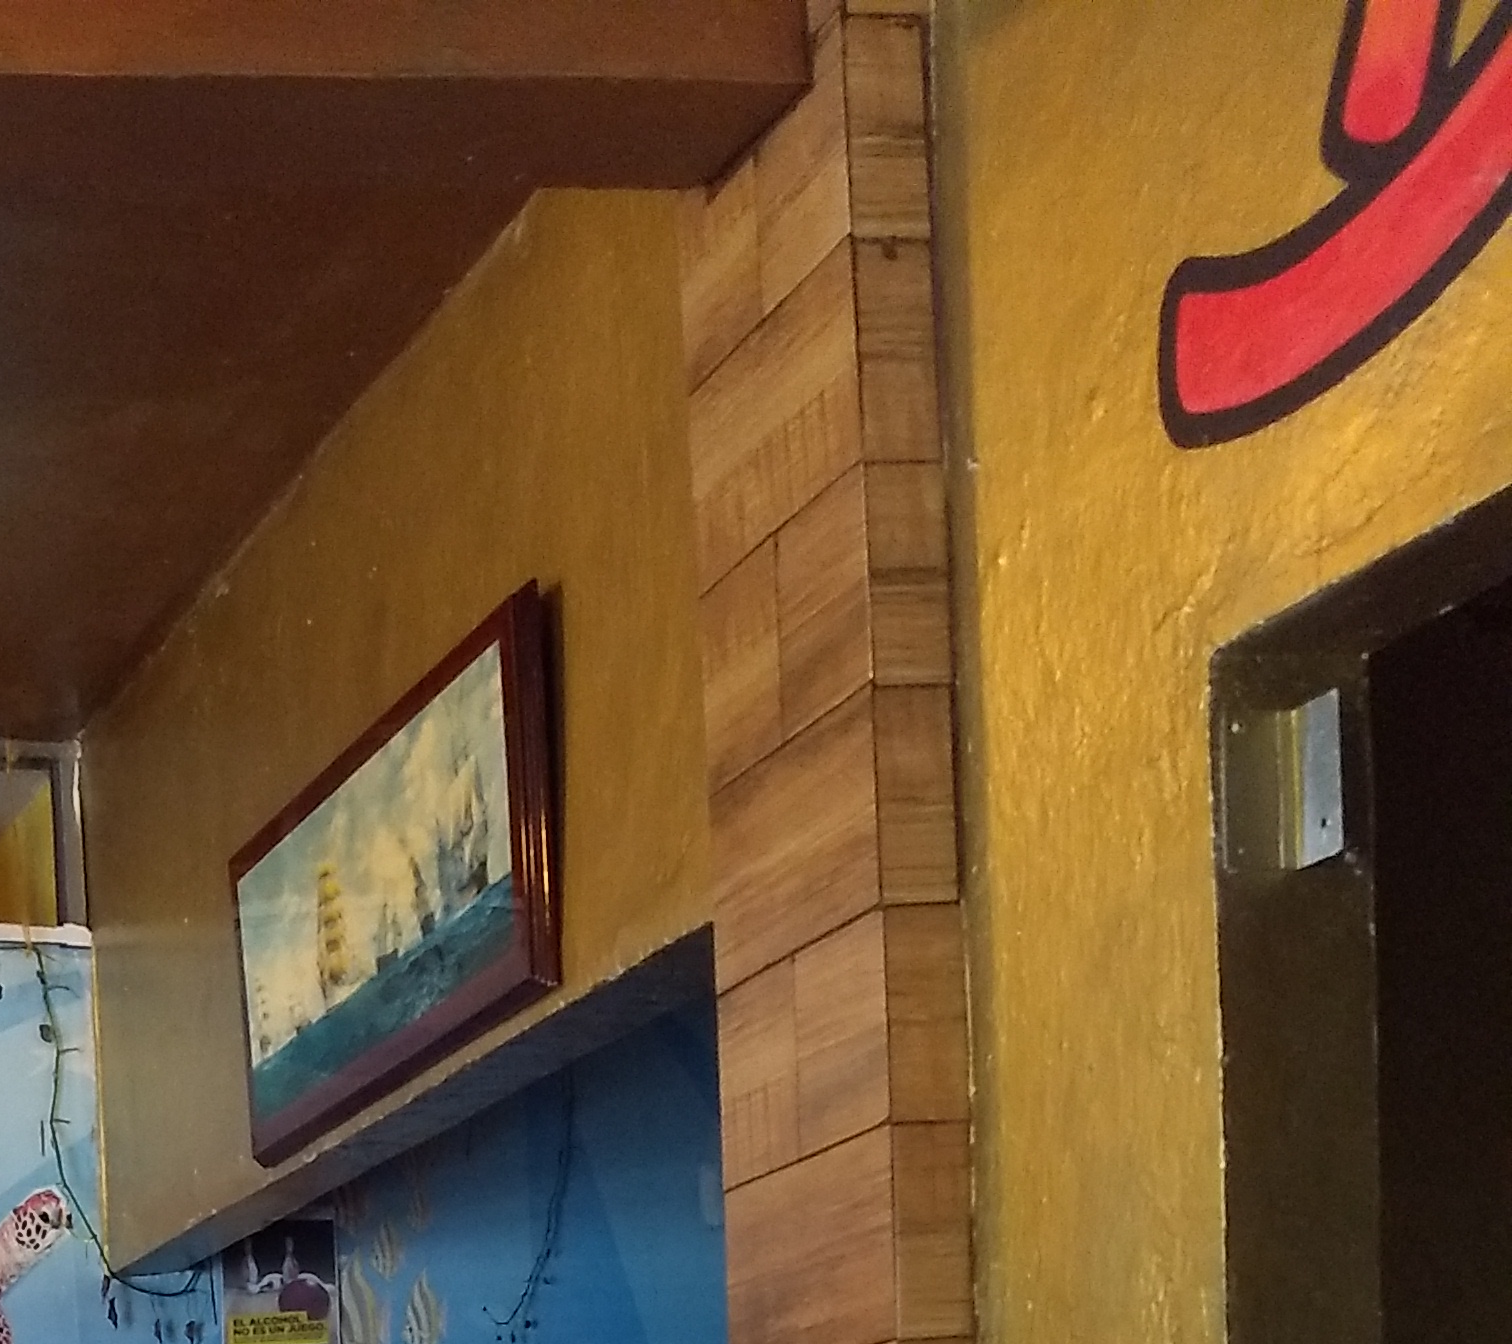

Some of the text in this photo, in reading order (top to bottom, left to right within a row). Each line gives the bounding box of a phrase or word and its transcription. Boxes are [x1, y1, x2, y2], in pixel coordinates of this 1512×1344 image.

[232, 1315, 300, 1328] EL ALCOHOL
[232, 1328, 249, 1336] NO
